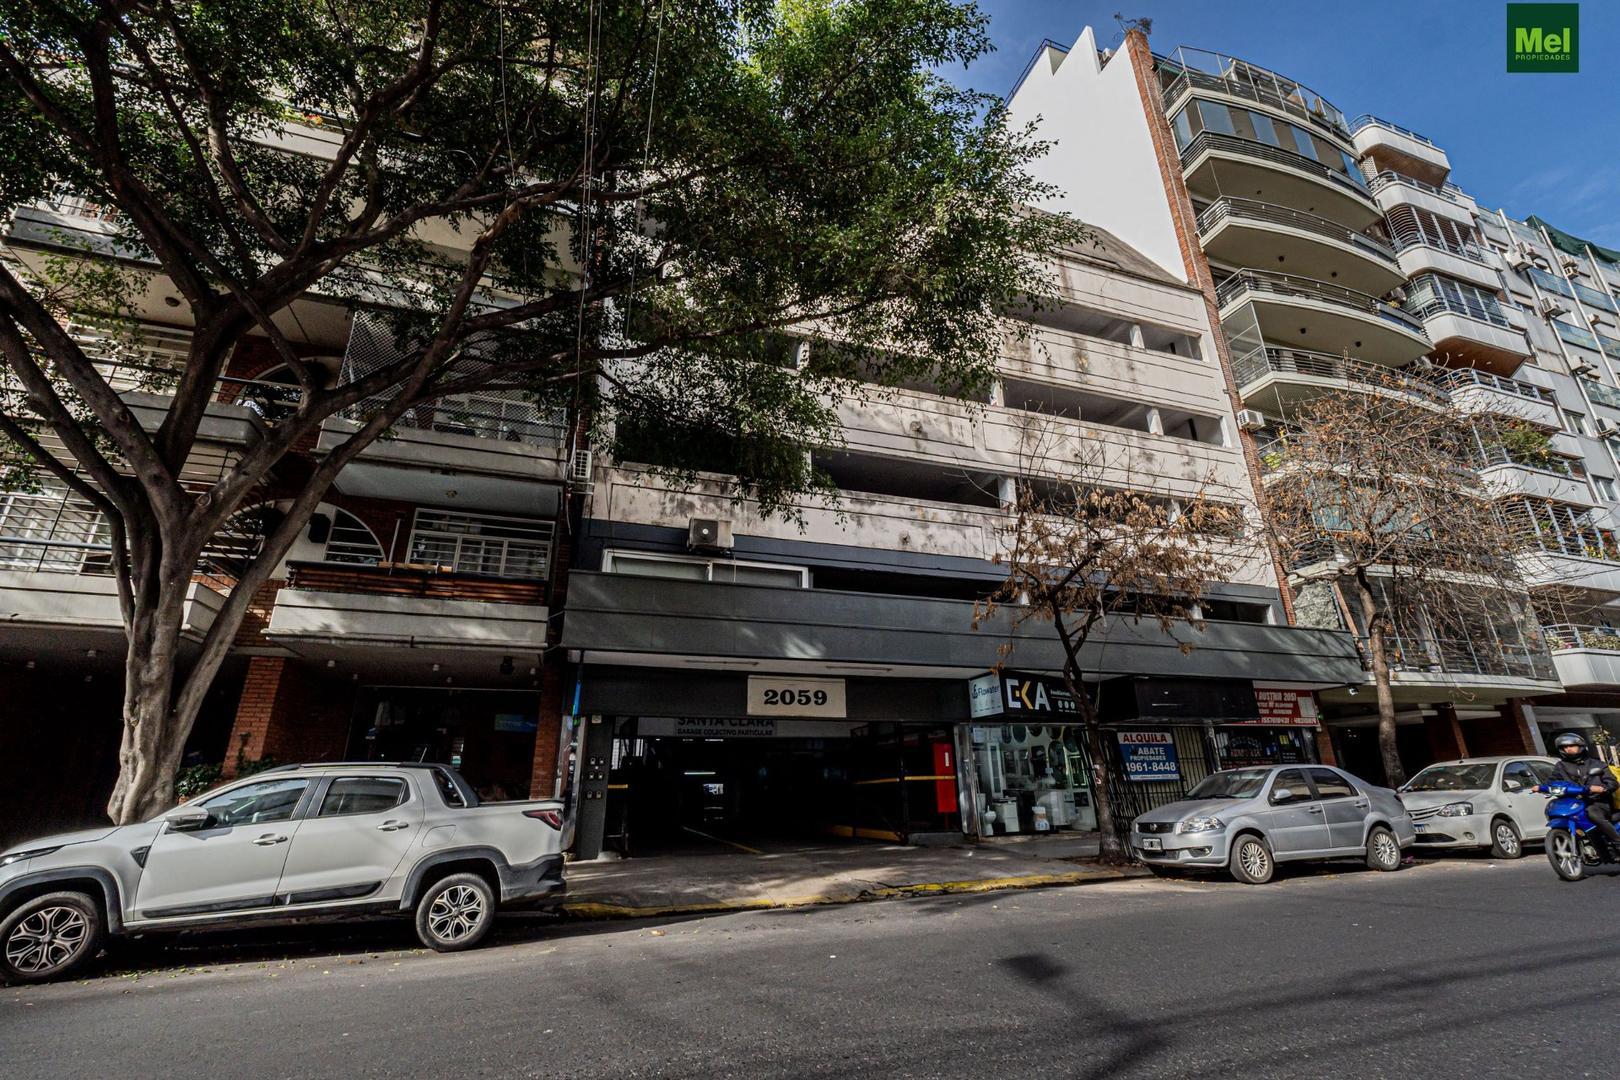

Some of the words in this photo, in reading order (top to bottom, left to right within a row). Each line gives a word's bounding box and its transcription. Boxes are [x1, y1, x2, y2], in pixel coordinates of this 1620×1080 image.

[763, 689, 828, 706] 2059
[1006, 678, 1052, 711] EKA
[677, 717, 725, 727] SANTA
[729, 718, 775, 728] CLARA
[1123, 733, 1168, 743] ALQUILA
[1138, 747, 1165, 755] ABATE
